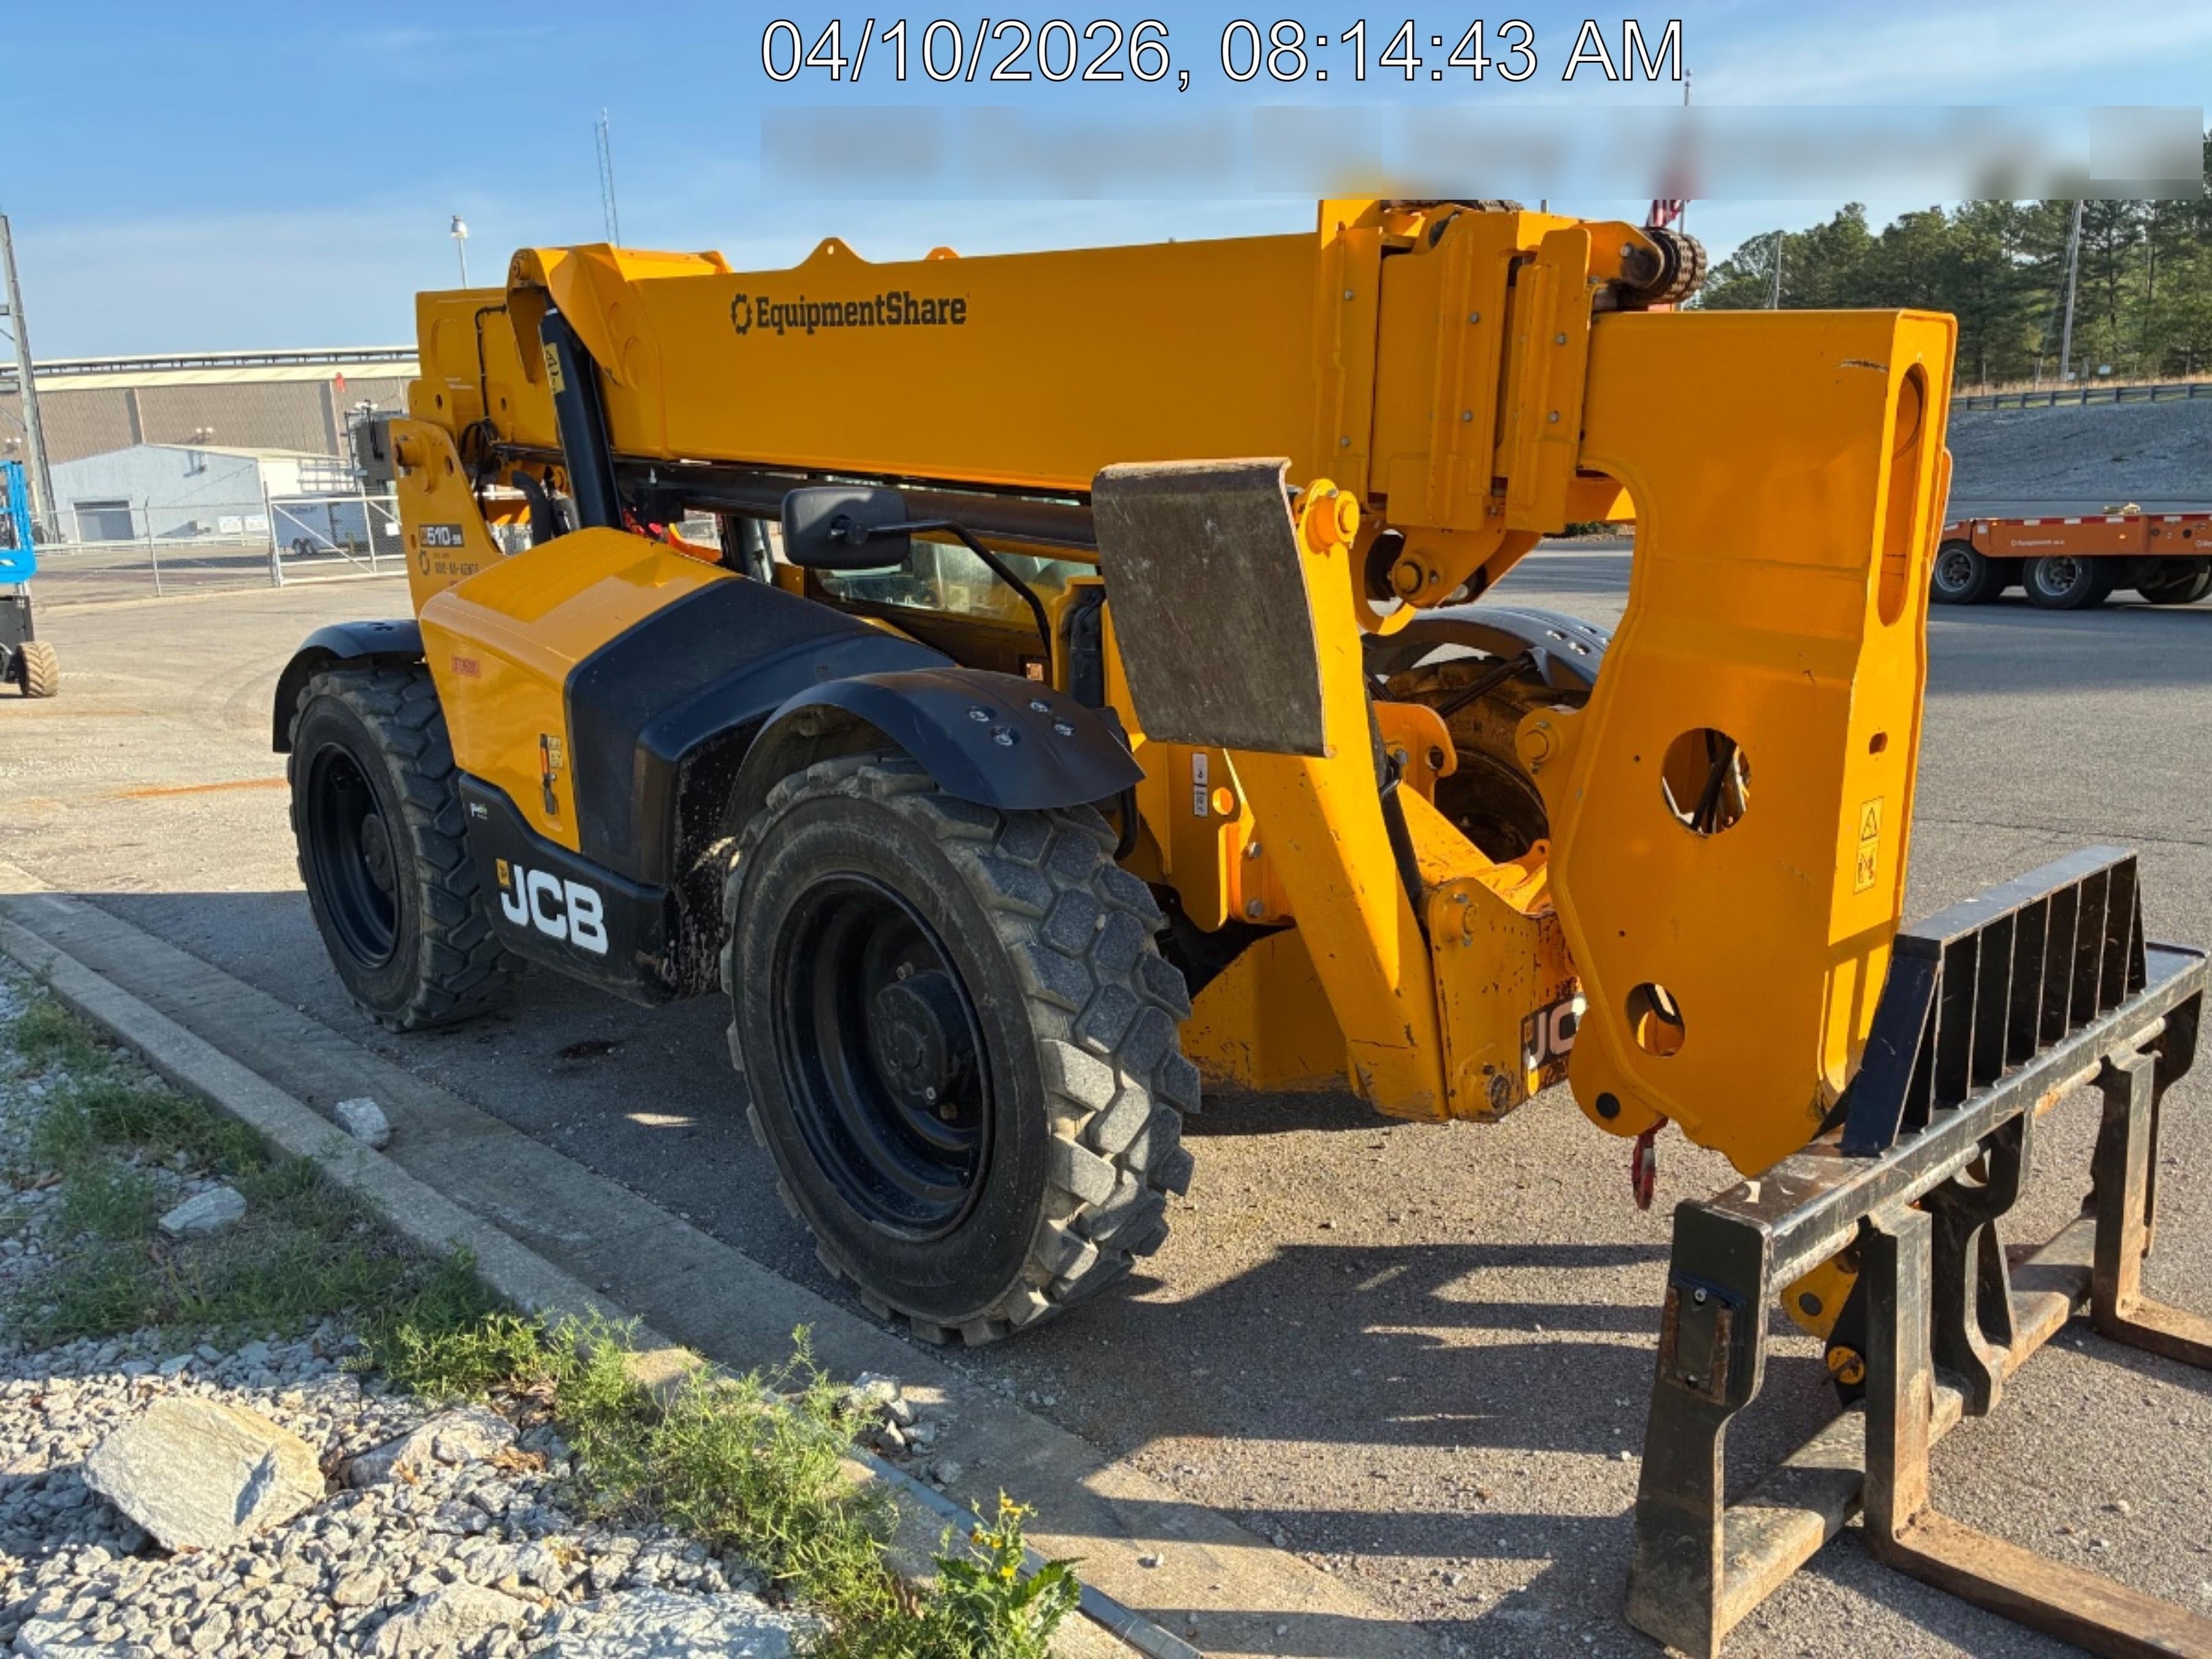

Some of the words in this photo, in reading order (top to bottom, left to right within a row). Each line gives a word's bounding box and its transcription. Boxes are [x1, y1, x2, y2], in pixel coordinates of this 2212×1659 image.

[756, 291, 967, 335] EquipmentShare
[500, 863, 609, 955] JCB
[1523, 997, 1587, 1070] JC
